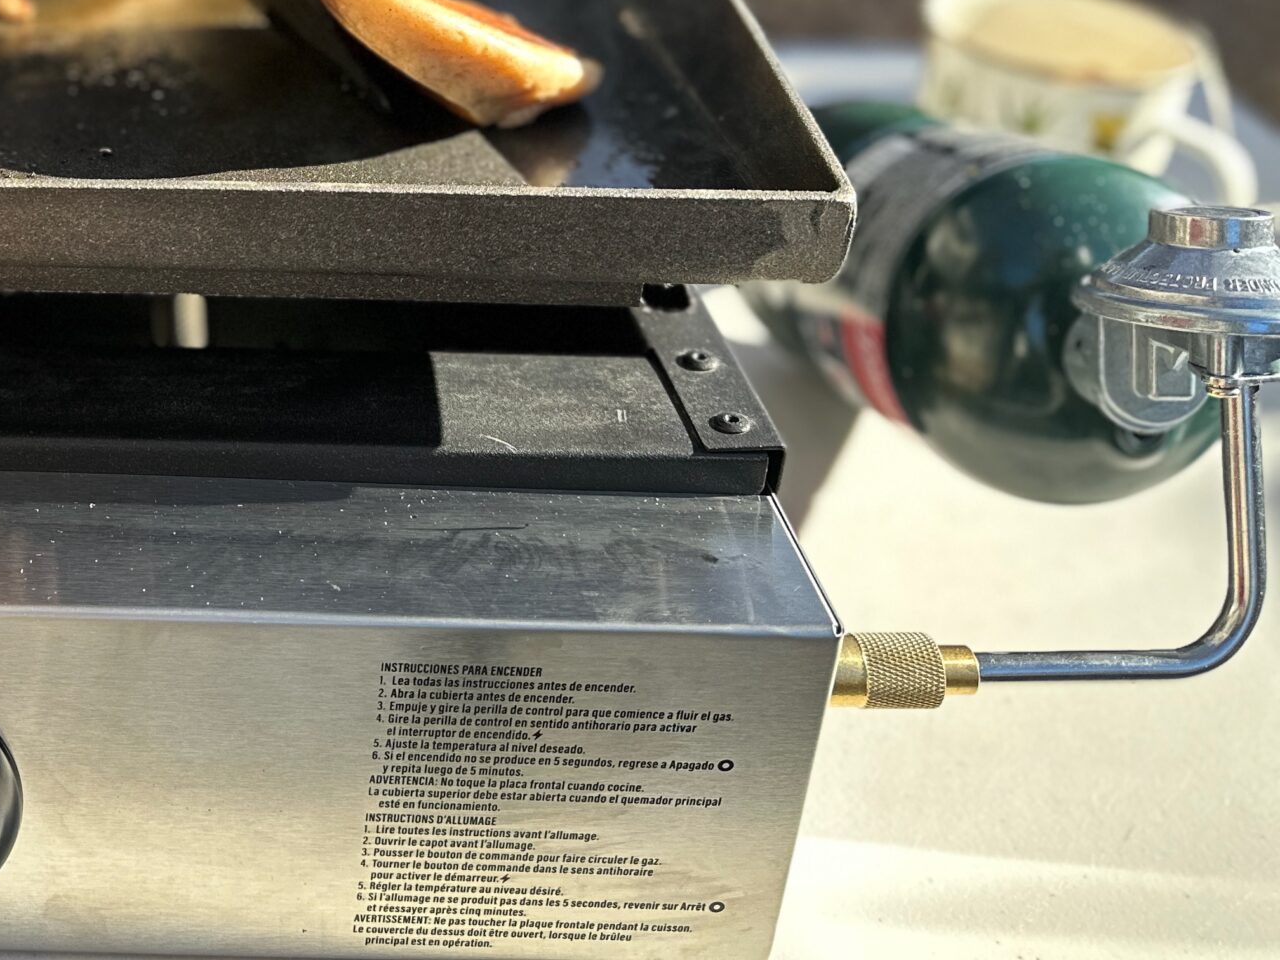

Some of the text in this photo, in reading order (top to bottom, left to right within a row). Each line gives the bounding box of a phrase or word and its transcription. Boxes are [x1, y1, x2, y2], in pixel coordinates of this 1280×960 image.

[381, 662, 543, 677] INSTRUCCIONES PARA ENCENDER
[380, 675, 636, 693] 1. Lea todas las instrucciones antes de encender.
[378, 688, 575, 704] 2. Abra la cubierta antes de encender.
[376, 714, 698, 734] 4. Gire la perilla de control en sentido antihorario para activar
[387, 726, 531, 741] el interruptor de encendido.
[379, 799, 501, 812] esté en funcionamiento.
[366, 813, 497, 826] INSTRUCTIONS D'ALLUMAGE
[365, 825, 600, 843] 1. Lire toutes les instructions avant l'allumage.
[363, 836, 536, 852] 2. Ouvrir le capot avant l'allumage.
[360, 859, 654, 877] 4. Tourner le bouton de commande dans le sens antihoraire
[371, 872, 499, 883] pour activer le démarreur.
[358, 881, 367, 890] 5.
[370, 881, 402, 893] Régler
[404, 882, 413, 892] la
[415, 883, 477, 894] température
[494, 886, 528, 895] niveau
[530, 886, 564, 897] désiré.
